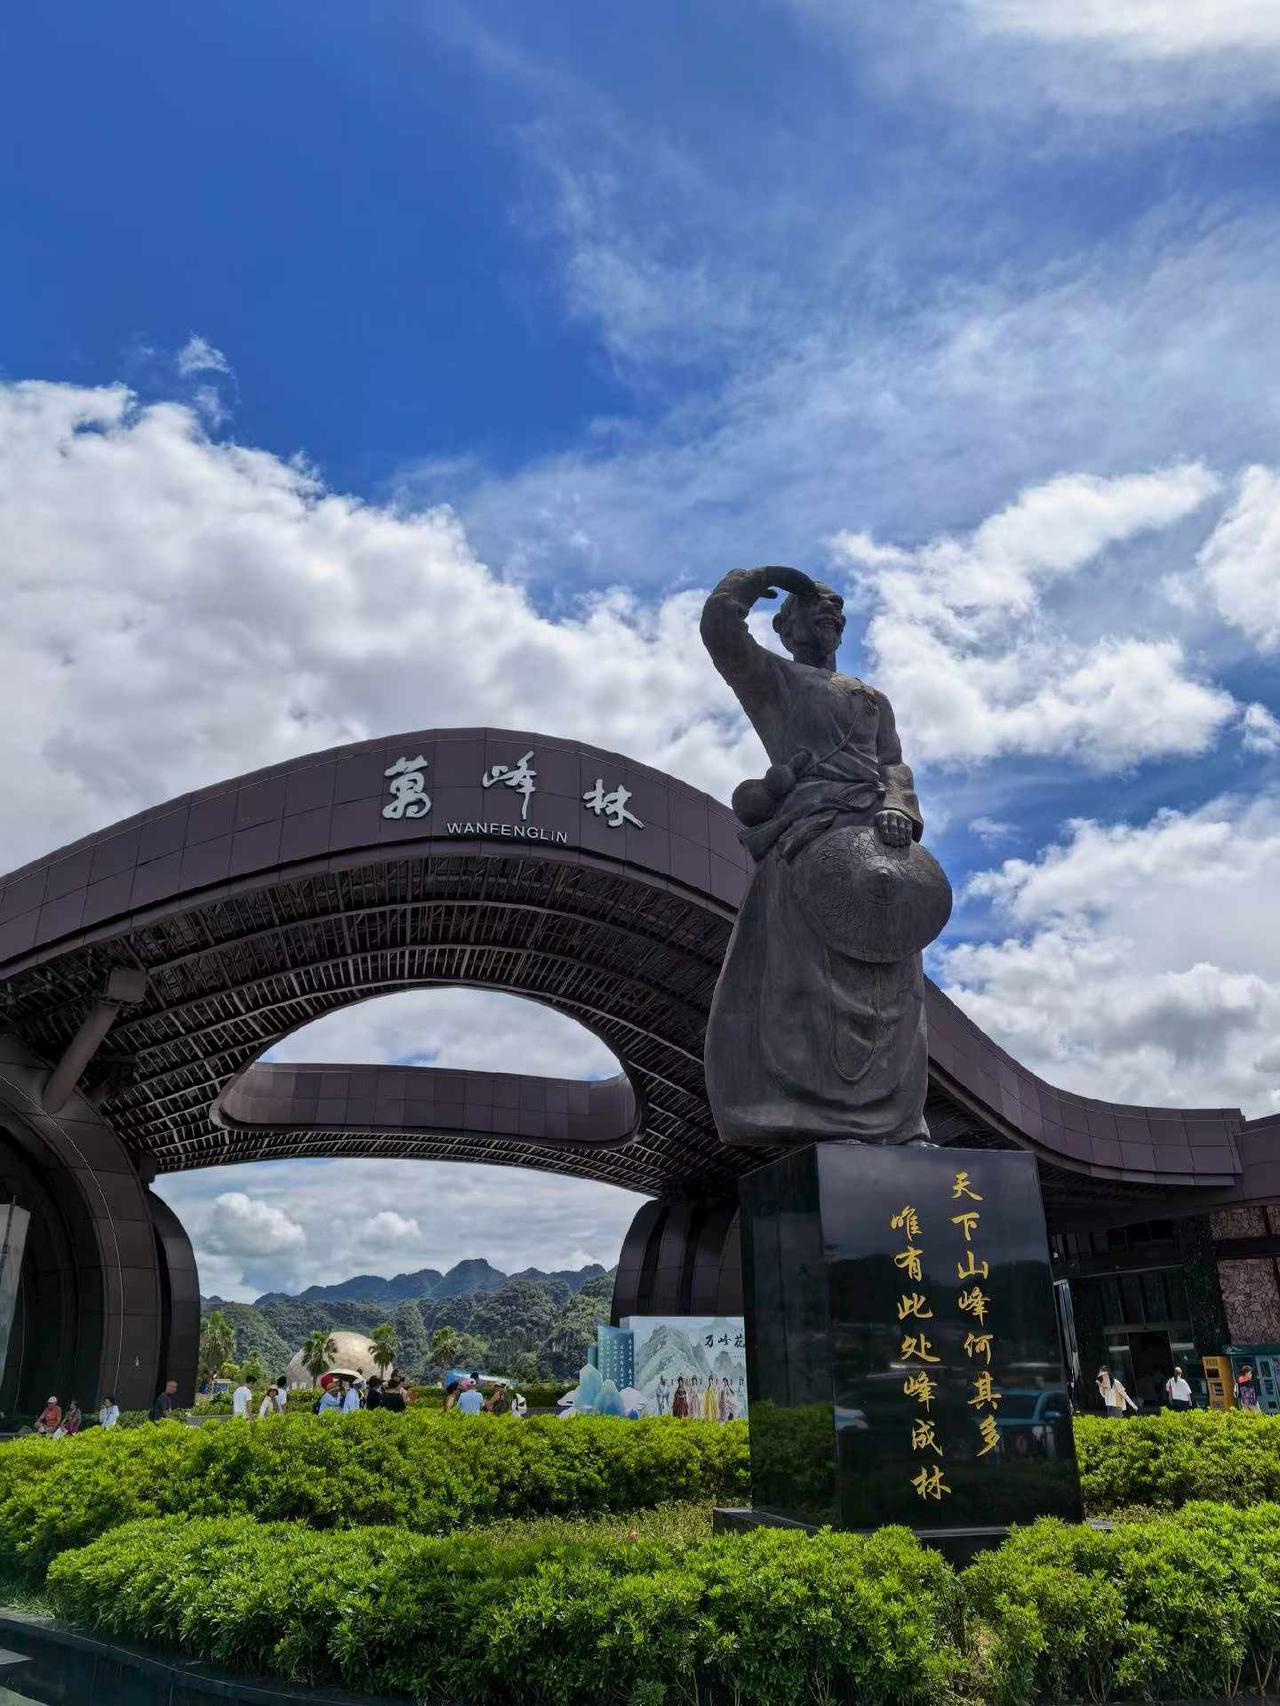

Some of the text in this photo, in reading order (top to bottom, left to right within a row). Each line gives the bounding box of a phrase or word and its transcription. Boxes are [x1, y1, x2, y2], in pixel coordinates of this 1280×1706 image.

[447, 822, 568, 843] WANFENGLIN
[951, 1171, 1002, 1457] 天下山峰何其多
